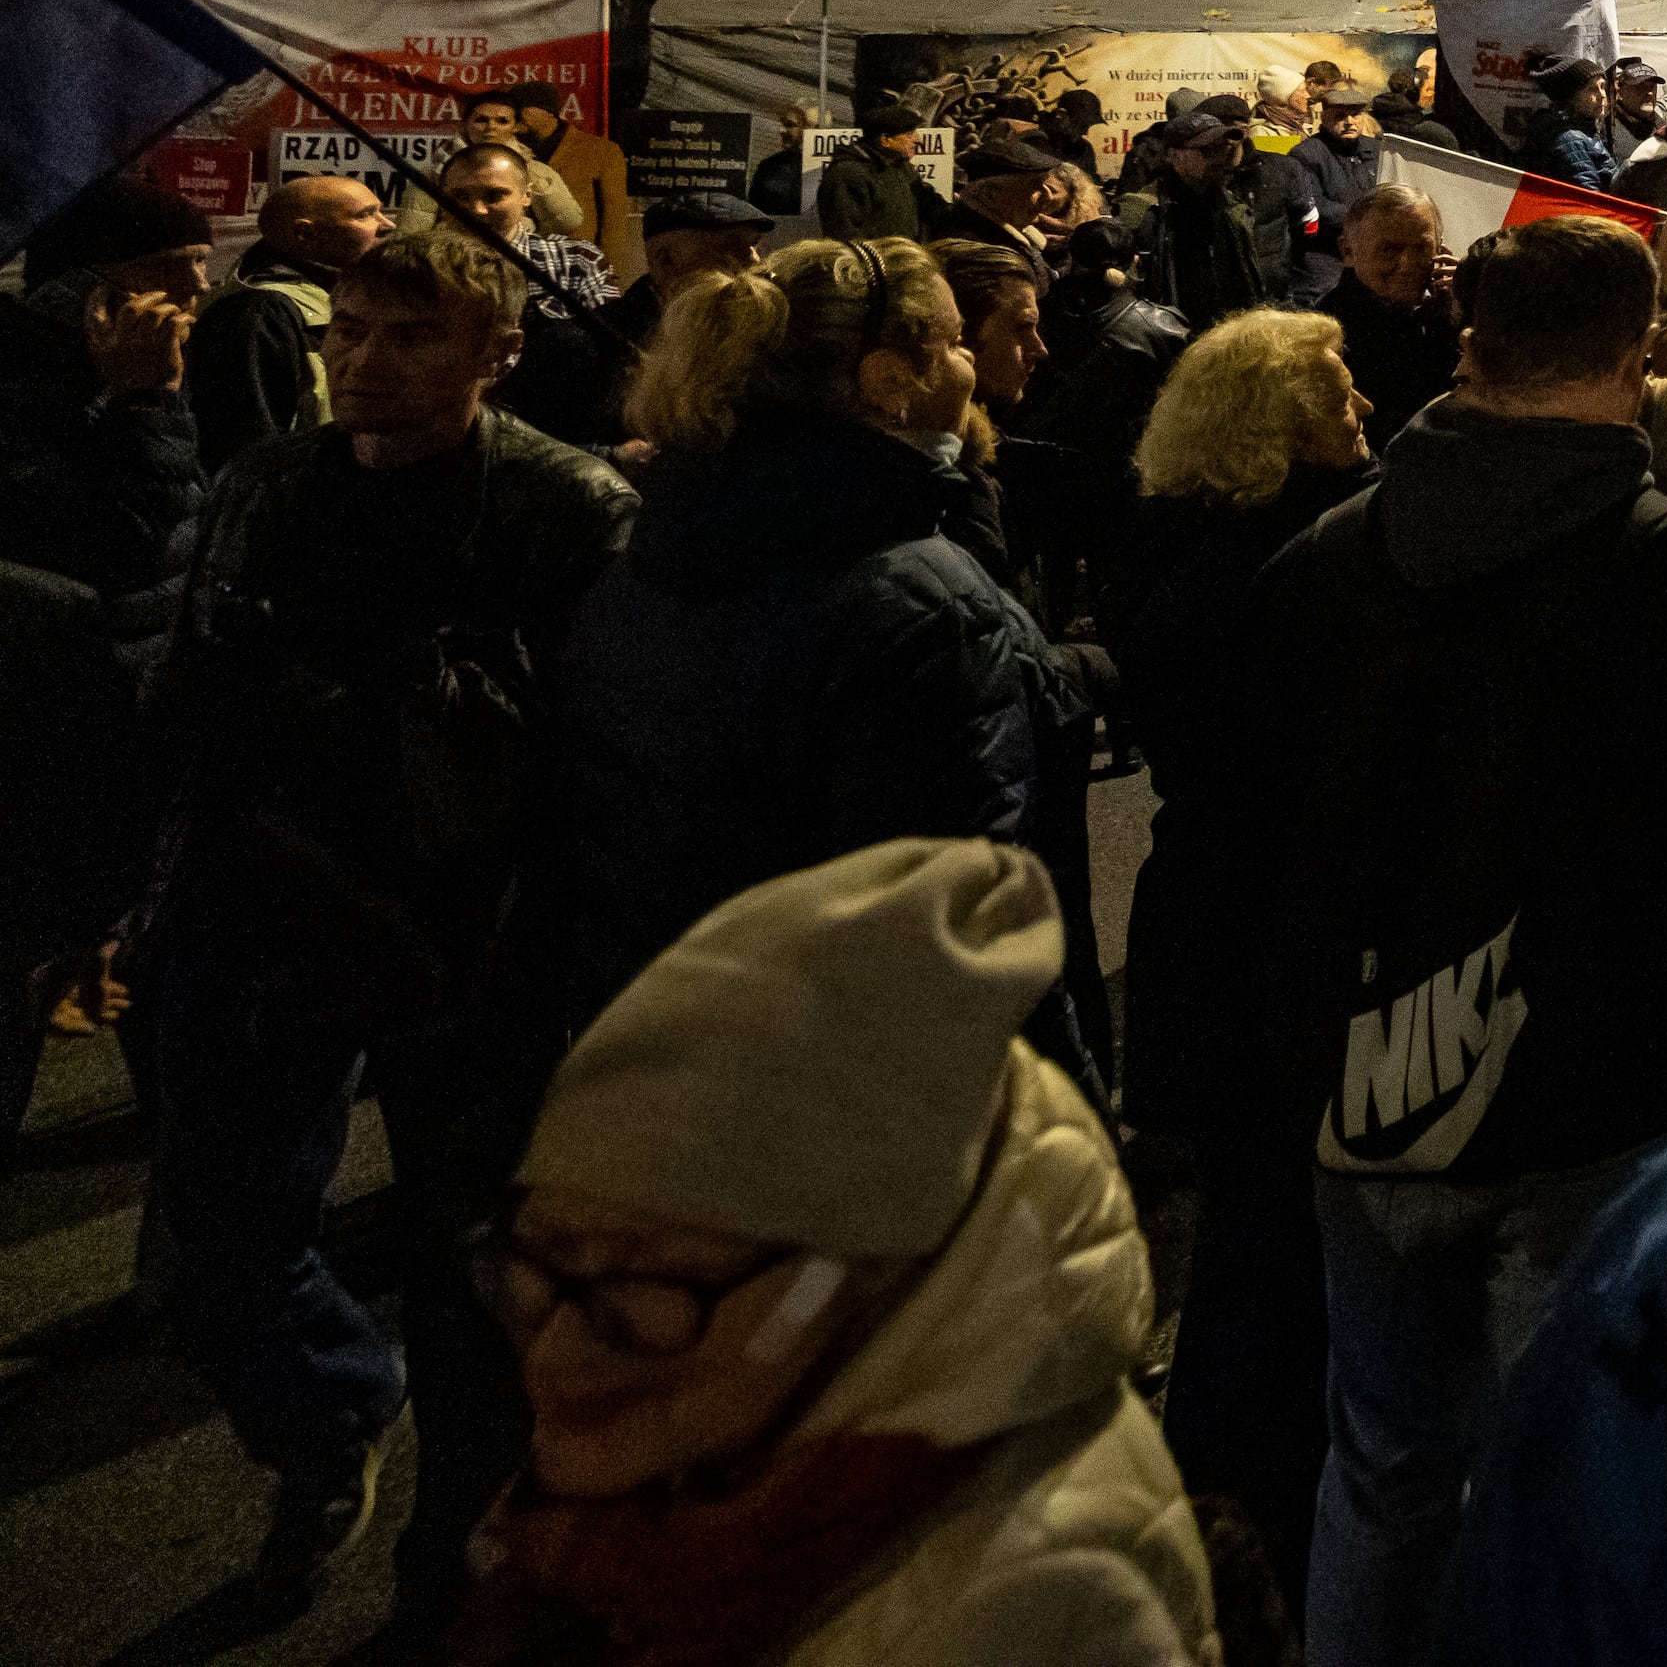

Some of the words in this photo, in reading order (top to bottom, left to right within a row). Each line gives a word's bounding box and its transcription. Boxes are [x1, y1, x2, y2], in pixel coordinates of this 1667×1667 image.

[403, 36, 489, 59] KLUB
[437, 63, 588, 87] POLSKIEJ
[1109, 70, 1123, 81] W
[1126, 70, 1163, 83] dużej
[1167, 70, 1214, 81] mierze
[1217, 70, 1250, 81] sami
[291, 93, 462, 127] JELENIA
[285, 136, 361, 167] RZĄD
[378, 137, 457, 162] TUSK
